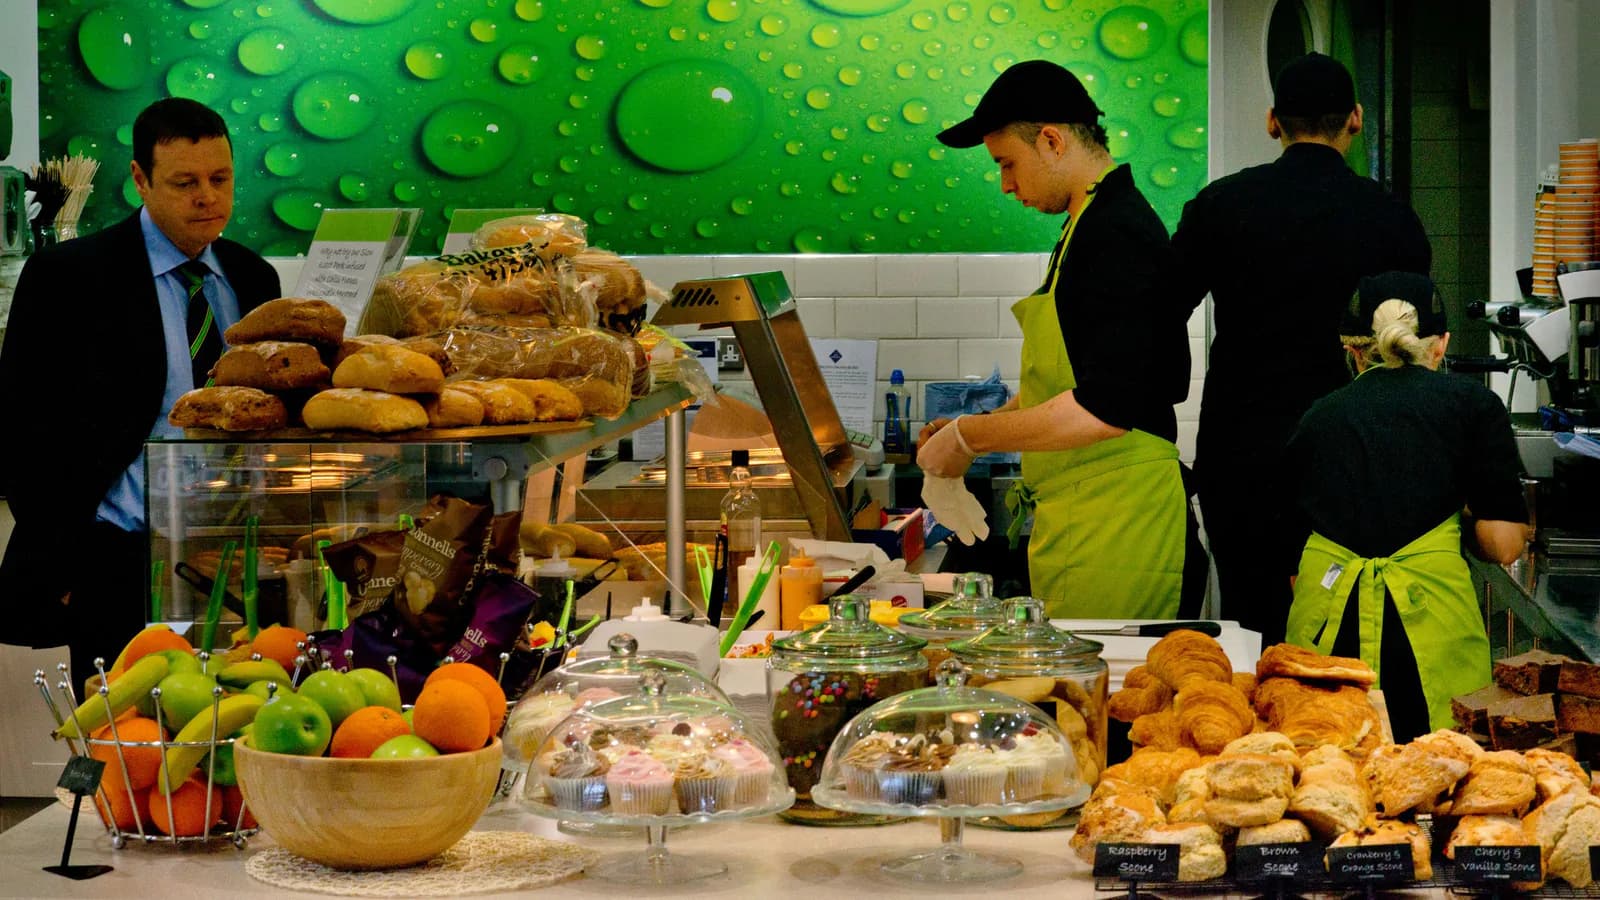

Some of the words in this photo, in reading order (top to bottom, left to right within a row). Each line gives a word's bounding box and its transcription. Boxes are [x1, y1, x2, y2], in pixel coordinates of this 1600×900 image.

[1108, 845, 1168, 862] Raspberry
[1259, 846, 1300, 856] Brown
[1346, 850, 1392, 862] Cranberry
[1474, 847, 1511, 861] Cherry
[1118, 862, 1155, 873] Scone
[1262, 862, 1299, 873] Scone
[1341, 863, 1375, 874] Orange
[1376, 862, 1403, 872] Scone
[1461, 860, 1501, 872] Vanilla
[1503, 861, 1537, 872] Scone
